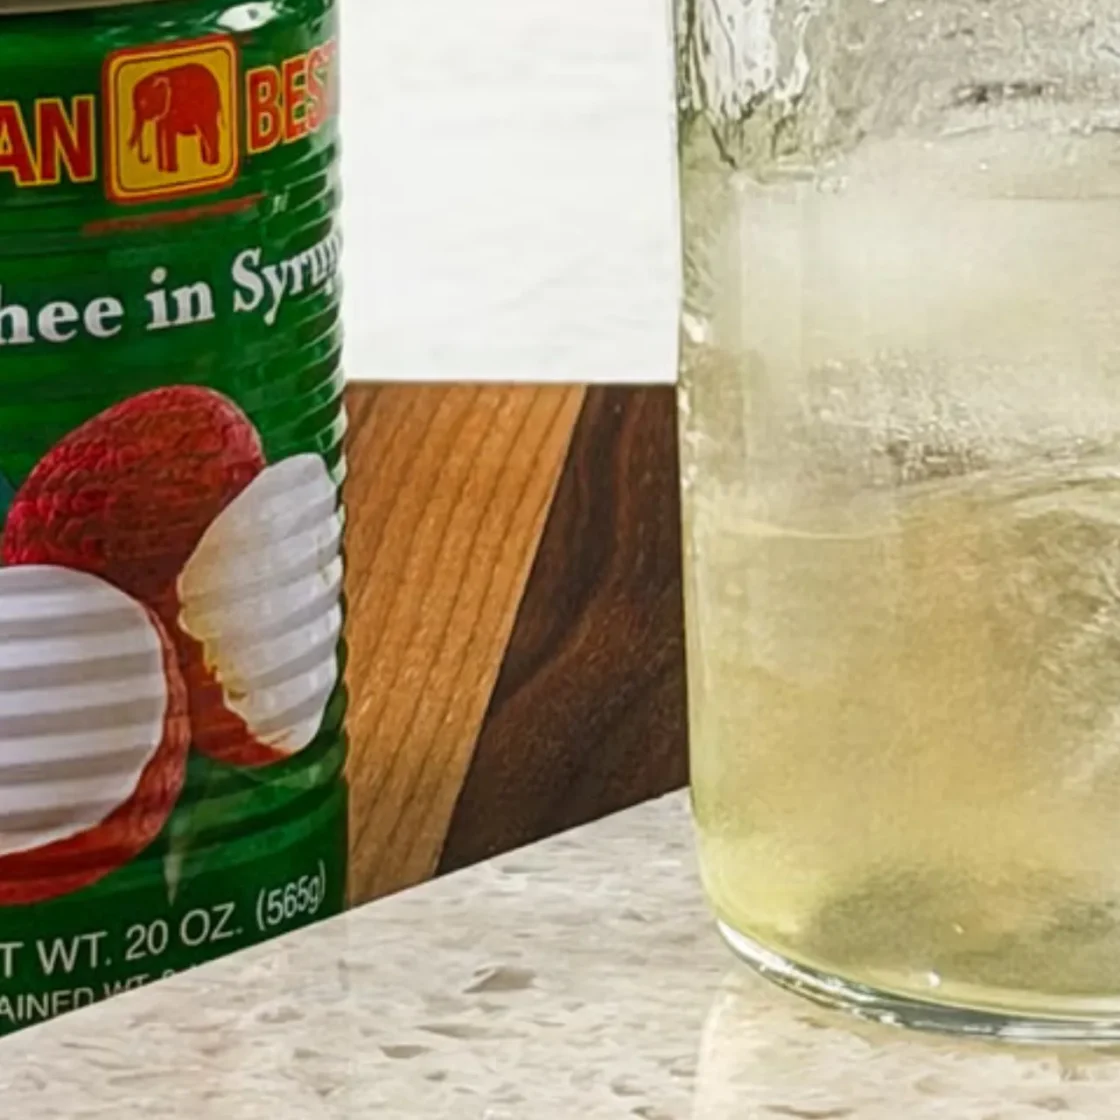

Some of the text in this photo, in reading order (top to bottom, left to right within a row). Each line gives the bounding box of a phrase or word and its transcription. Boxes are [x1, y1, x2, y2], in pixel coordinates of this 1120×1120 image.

[0, 94, 96, 188] AN
[0, 237, 341, 345] hee in Syrup
[36, 930, 113, 977] WT.
[125, 919, 169, 962] 20
[180, 902, 244, 947] OZ.
[255, 859, 327, 931] (565g)
